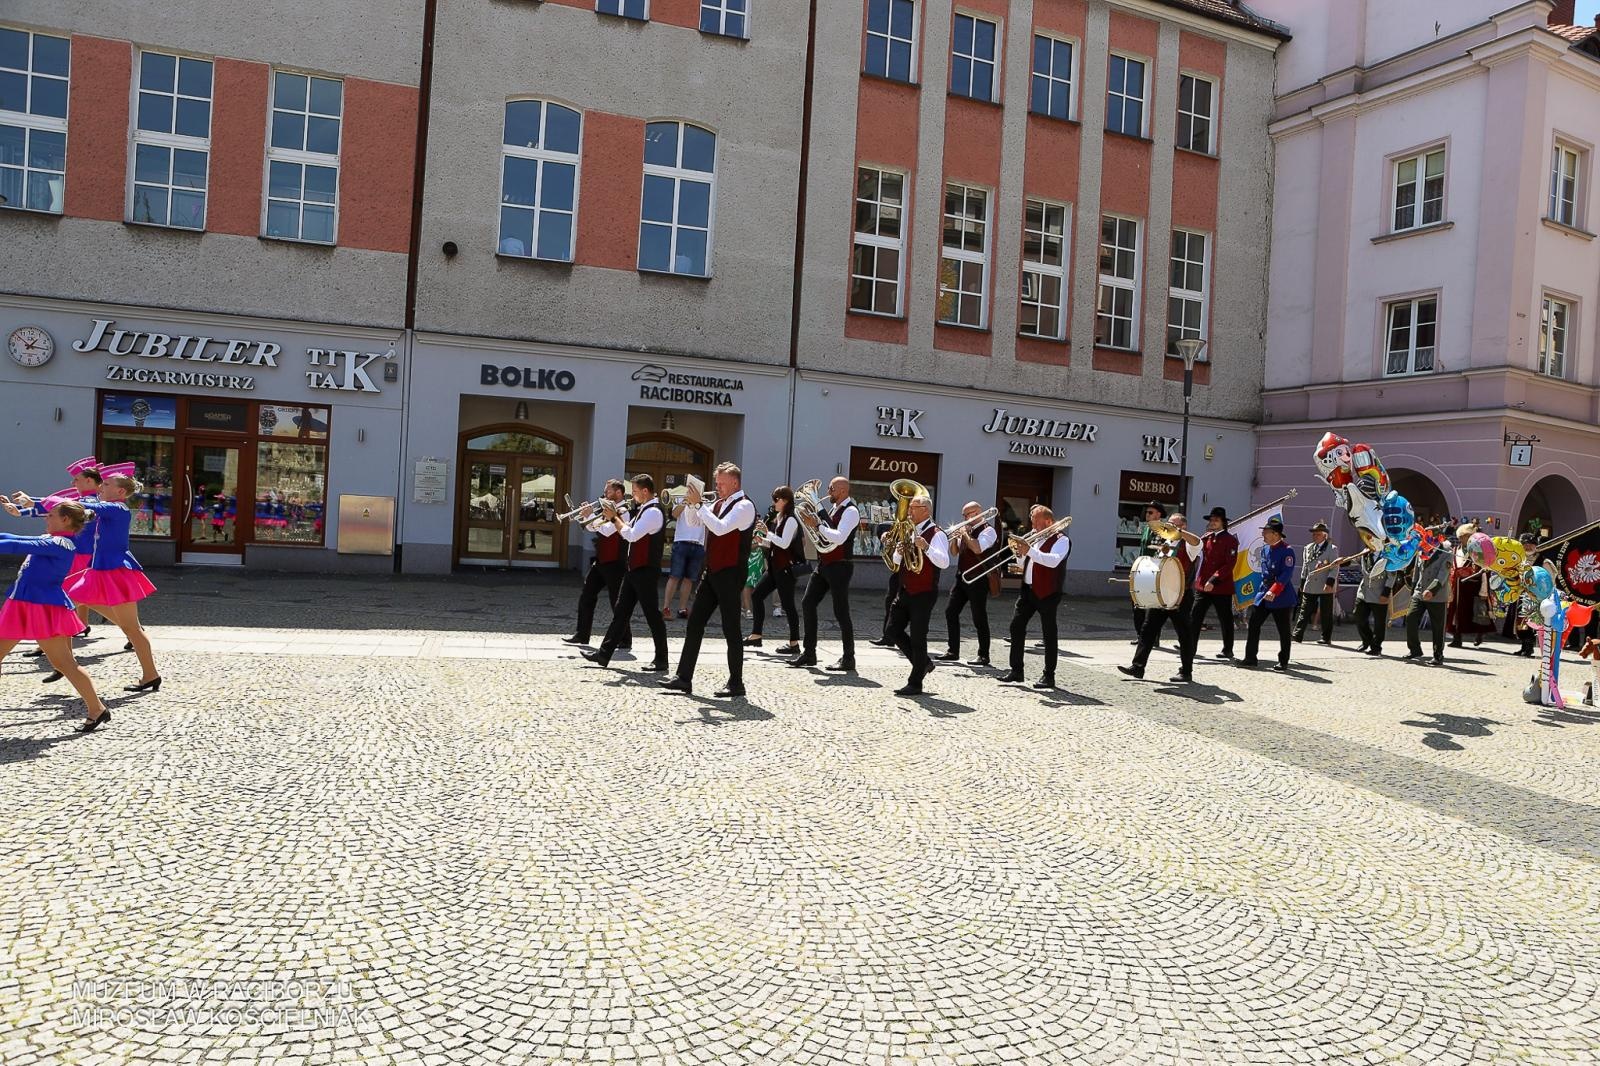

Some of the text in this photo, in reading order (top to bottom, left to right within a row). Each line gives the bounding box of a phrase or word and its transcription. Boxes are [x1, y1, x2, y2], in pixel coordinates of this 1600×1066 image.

[72, 319, 281, 367] JUBILER
[106, 364, 256, 390] ZEGARMISTRZ
[480, 363, 576, 392] BOLKO
[668, 374, 744, 391] RESTAURACJA
[640, 385, 733, 407] RACIBORSKA
[983, 408, 1099, 442] JUBILER
[1010, 440, 1067, 458] ZŁOTNIK
[868, 456, 919, 474] ZŁOTO
[1129, 479, 1175, 495] SREBRO
